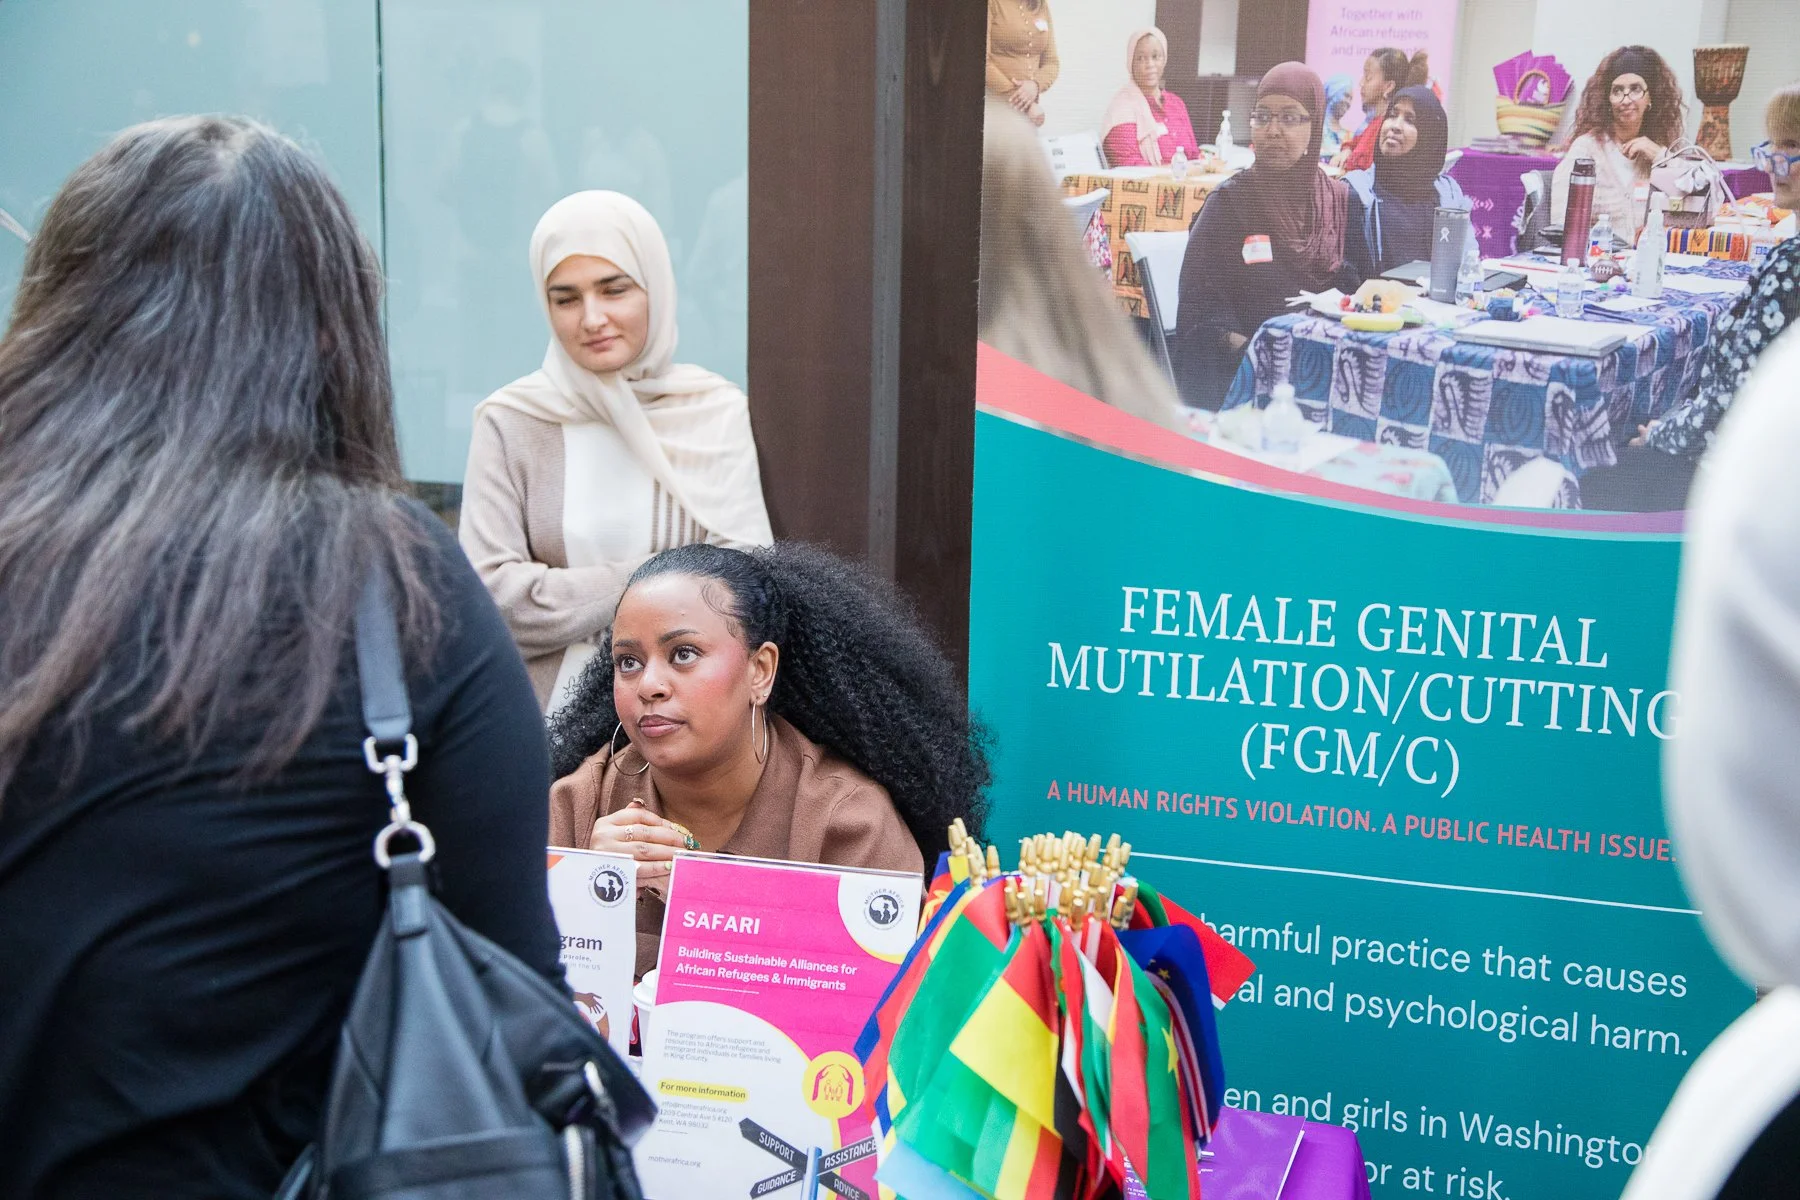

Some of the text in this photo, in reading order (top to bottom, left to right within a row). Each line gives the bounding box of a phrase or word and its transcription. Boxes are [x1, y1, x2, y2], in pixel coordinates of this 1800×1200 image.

[1341, 7, 1423, 21] Together with
[1330, 25, 1428, 41] African refugees
[1331, 44, 1354, 56] and
[1120, 586, 1608, 668] FEMALE GENITAL
[1046, 642, 1683, 740] MUTILATION/CUTTING
[1241, 722, 1460, 799] (FGM/C)
[1047, 780, 1678, 863] A HUMAN RIGHTS VIOLATION. A PUBLIC HEALTH ISSUE.
[588, 864, 630, 885] MOTHER AFRICA
[864, 888, 905, 908] MOTHER AFRICA
[682, 911, 761, 935] SAFARI
[678, 946, 858, 976] Building Sustainable Alliances for
[1331, 935, 1471, 973] practice
[1482, 945, 1552, 982] that
[1563, 962, 1688, 998] causes
[675, 963, 847, 992] African Refugees & Immigrants
[1228, 973, 1689, 1057] al and psychological harm.
[660, 1082, 674, 1090] For
[698, 1087, 746, 1099] information
[1271, 1091, 1332, 1122] and
[1341, 1097, 1409, 1134] girls
[1419, 1105, 1448, 1139] in
[1459, 1110, 1652, 1169] Washingto
[758, 1131, 795, 1162] SUPPORT
[824, 1139, 877, 1169] ASSISTANCE
[648, 1155, 702, 1168] motherafrica.org
[757, 1170, 797, 1194] GUIDANCE
[833, 1178, 860, 1200] ADVICE
[1402, 1165, 1436, 1193] at
